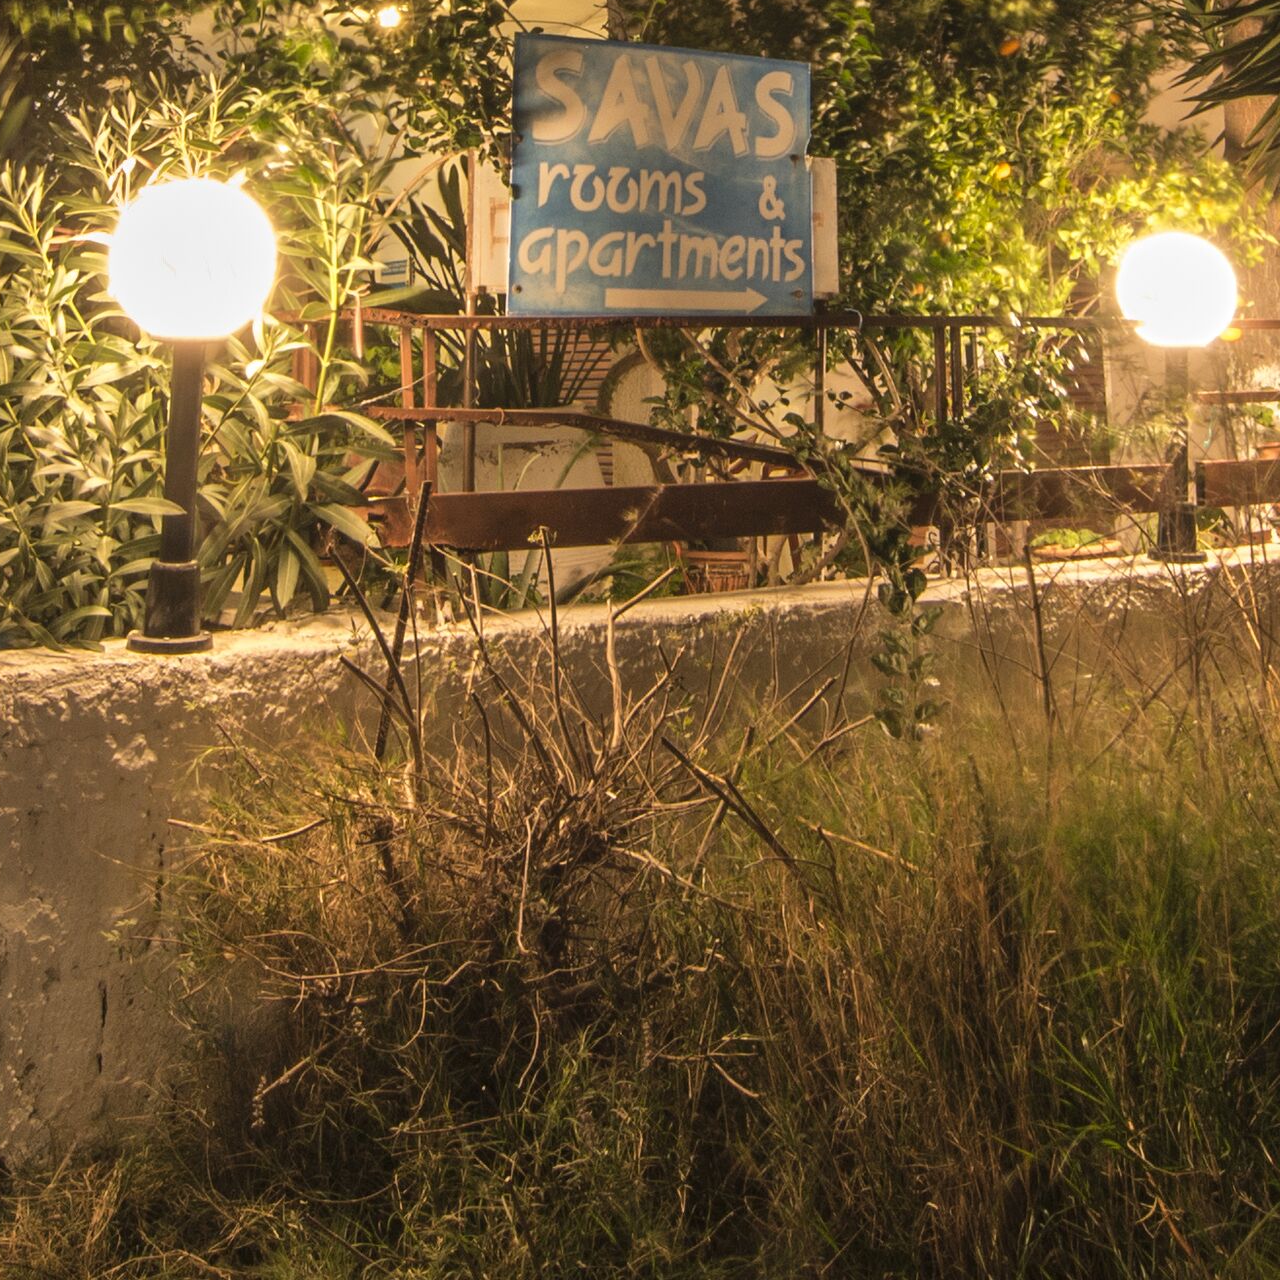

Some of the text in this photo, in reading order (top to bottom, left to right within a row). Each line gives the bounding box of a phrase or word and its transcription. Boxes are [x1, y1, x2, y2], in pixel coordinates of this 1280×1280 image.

[532, 48, 796, 161] SAVAS
[538, 160, 786, 220] rooms &
[518, 219, 806, 296] apartments
